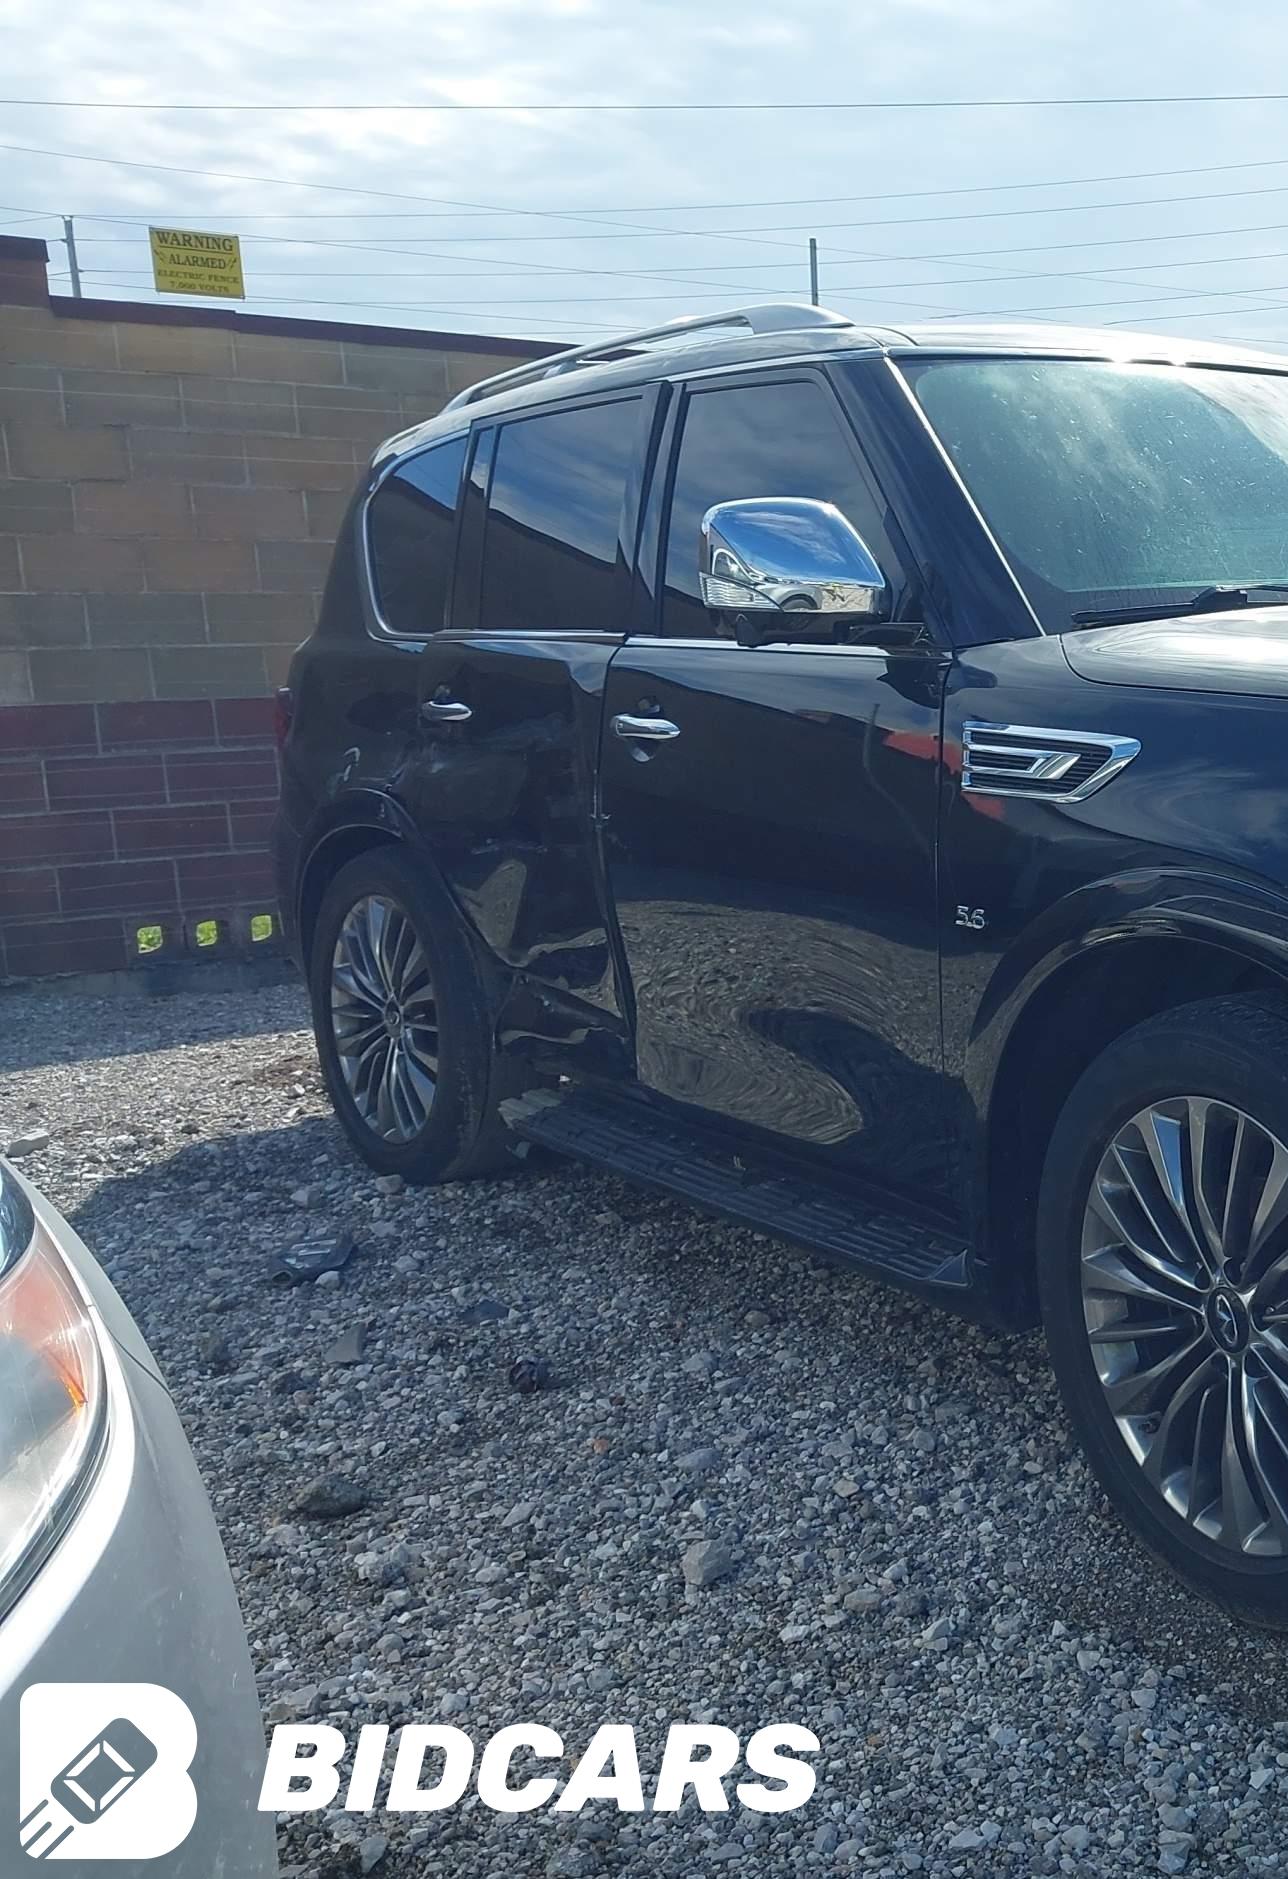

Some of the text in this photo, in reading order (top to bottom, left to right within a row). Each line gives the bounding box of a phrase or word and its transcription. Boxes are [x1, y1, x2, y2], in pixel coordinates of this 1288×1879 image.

[155, 231, 234, 252] WARNING
[169, 253, 226, 270] ALARMED
[157, 269, 240, 285] ELECTRIC FENCE
[198, 283, 230, 293] VOLTS
